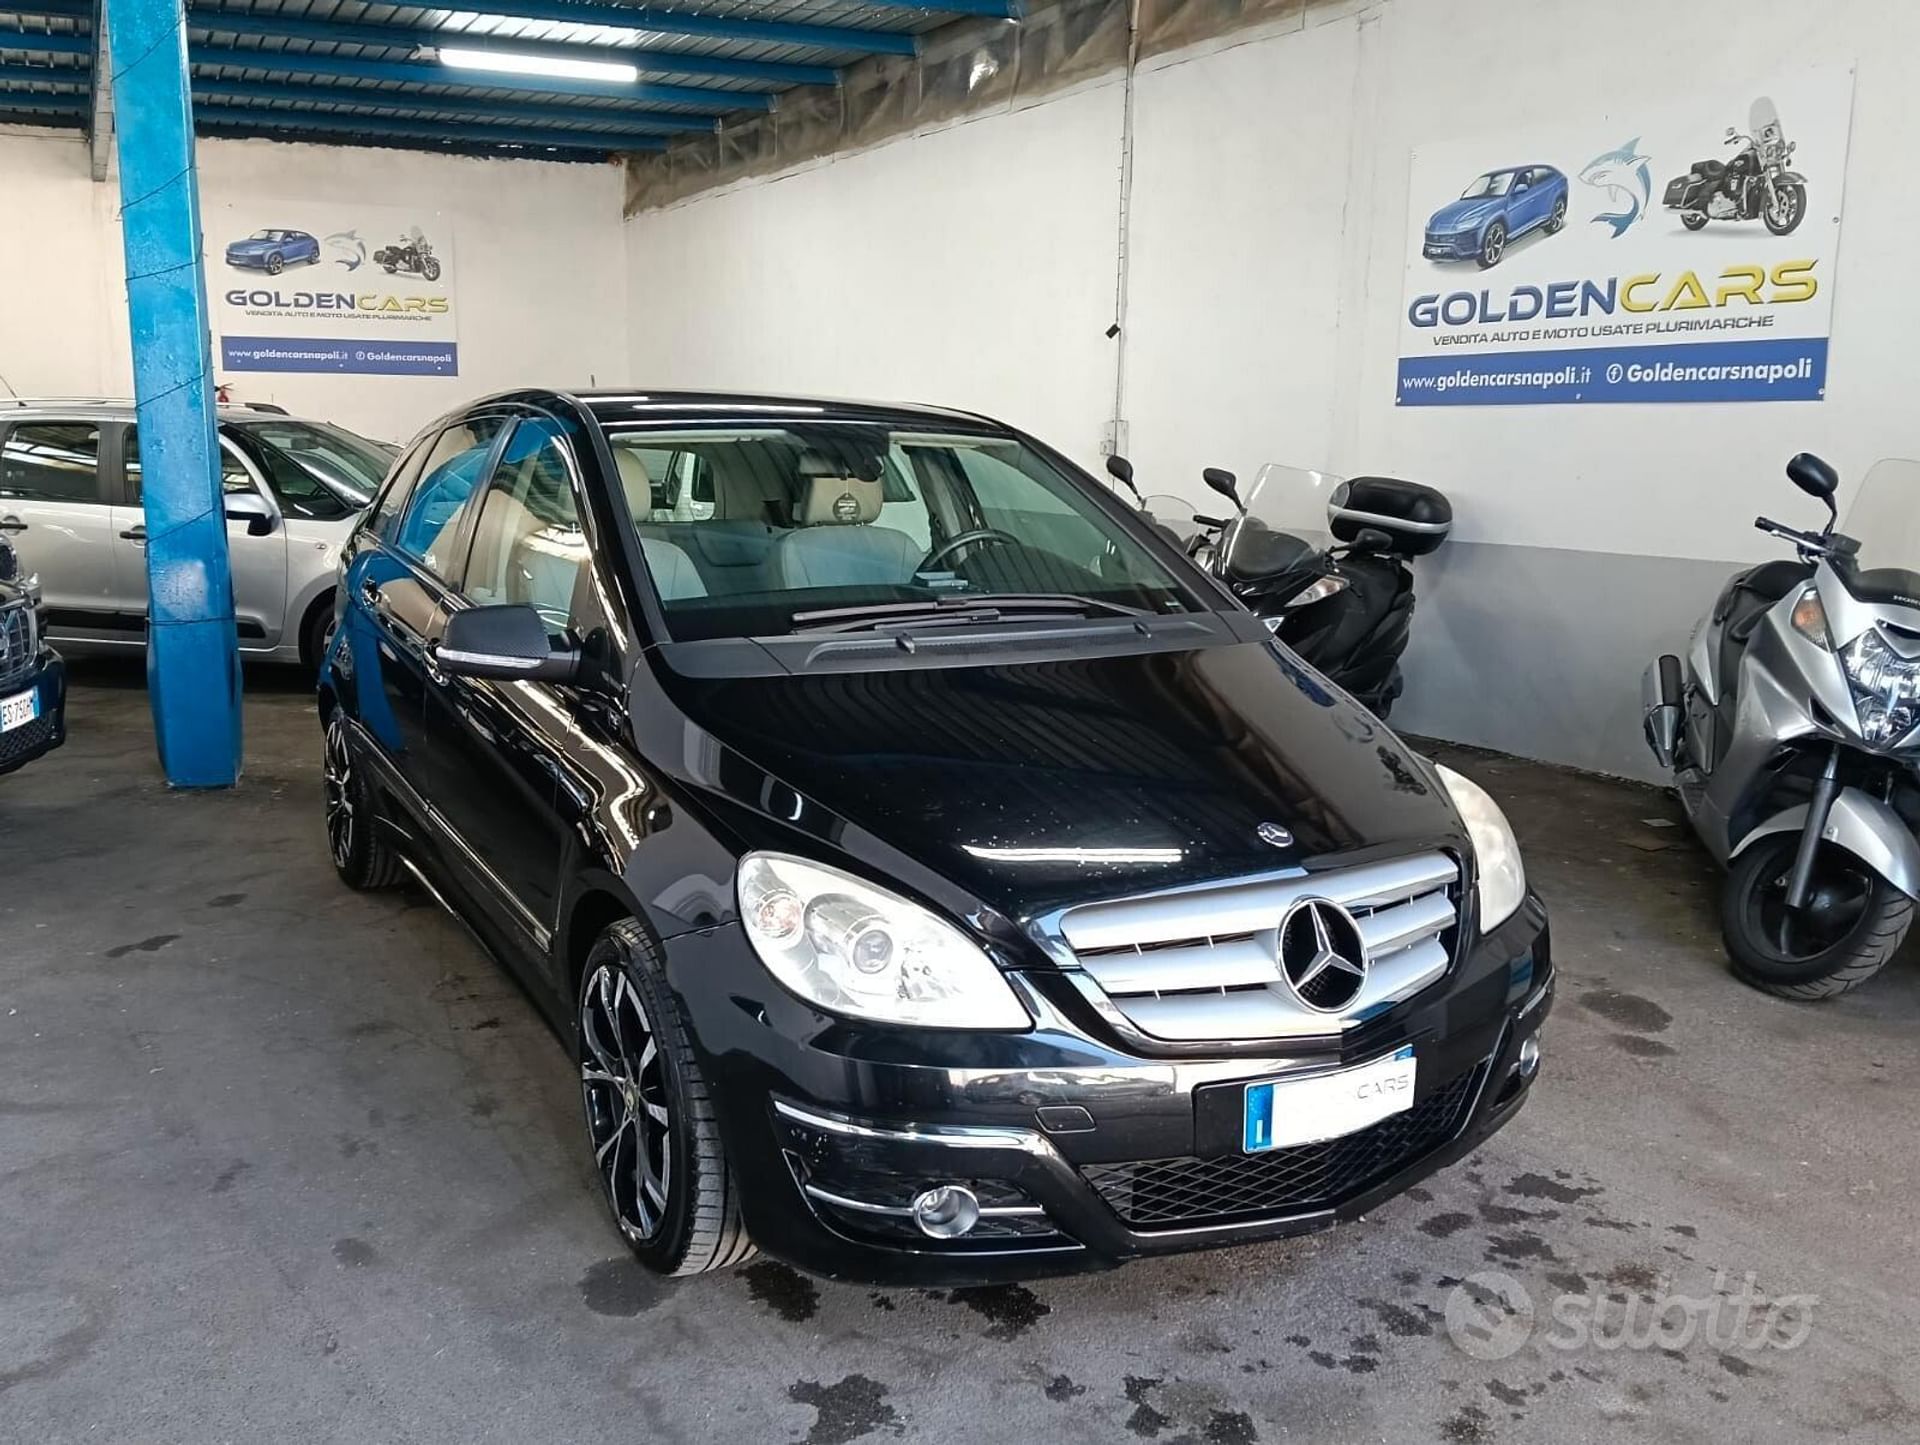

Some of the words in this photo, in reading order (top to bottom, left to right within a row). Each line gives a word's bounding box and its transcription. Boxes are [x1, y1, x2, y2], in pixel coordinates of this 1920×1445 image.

[225, 290, 449, 313] GOLDENCARS
[1408, 259, 1818, 327] GOLDENCARS
[1433, 333, 1488, 346] VENDITA
[1490, 330, 1529, 342] AUTO
[1532, 329, 1541, 340] E
[1543, 327, 1588, 339] MOTO
[1591, 323, 1643, 336] USATE
[1645, 315, 1775, 333] PLURIMARCHE
[228, 349, 348, 361] www.goldencarsnapoli.it
[367, 351, 452, 364] Goldencarsnapoli
[1403, 366, 1592, 392] www.goldencarsnapoli.it
[1627, 358, 1813, 384] Goldencarsnapoli
